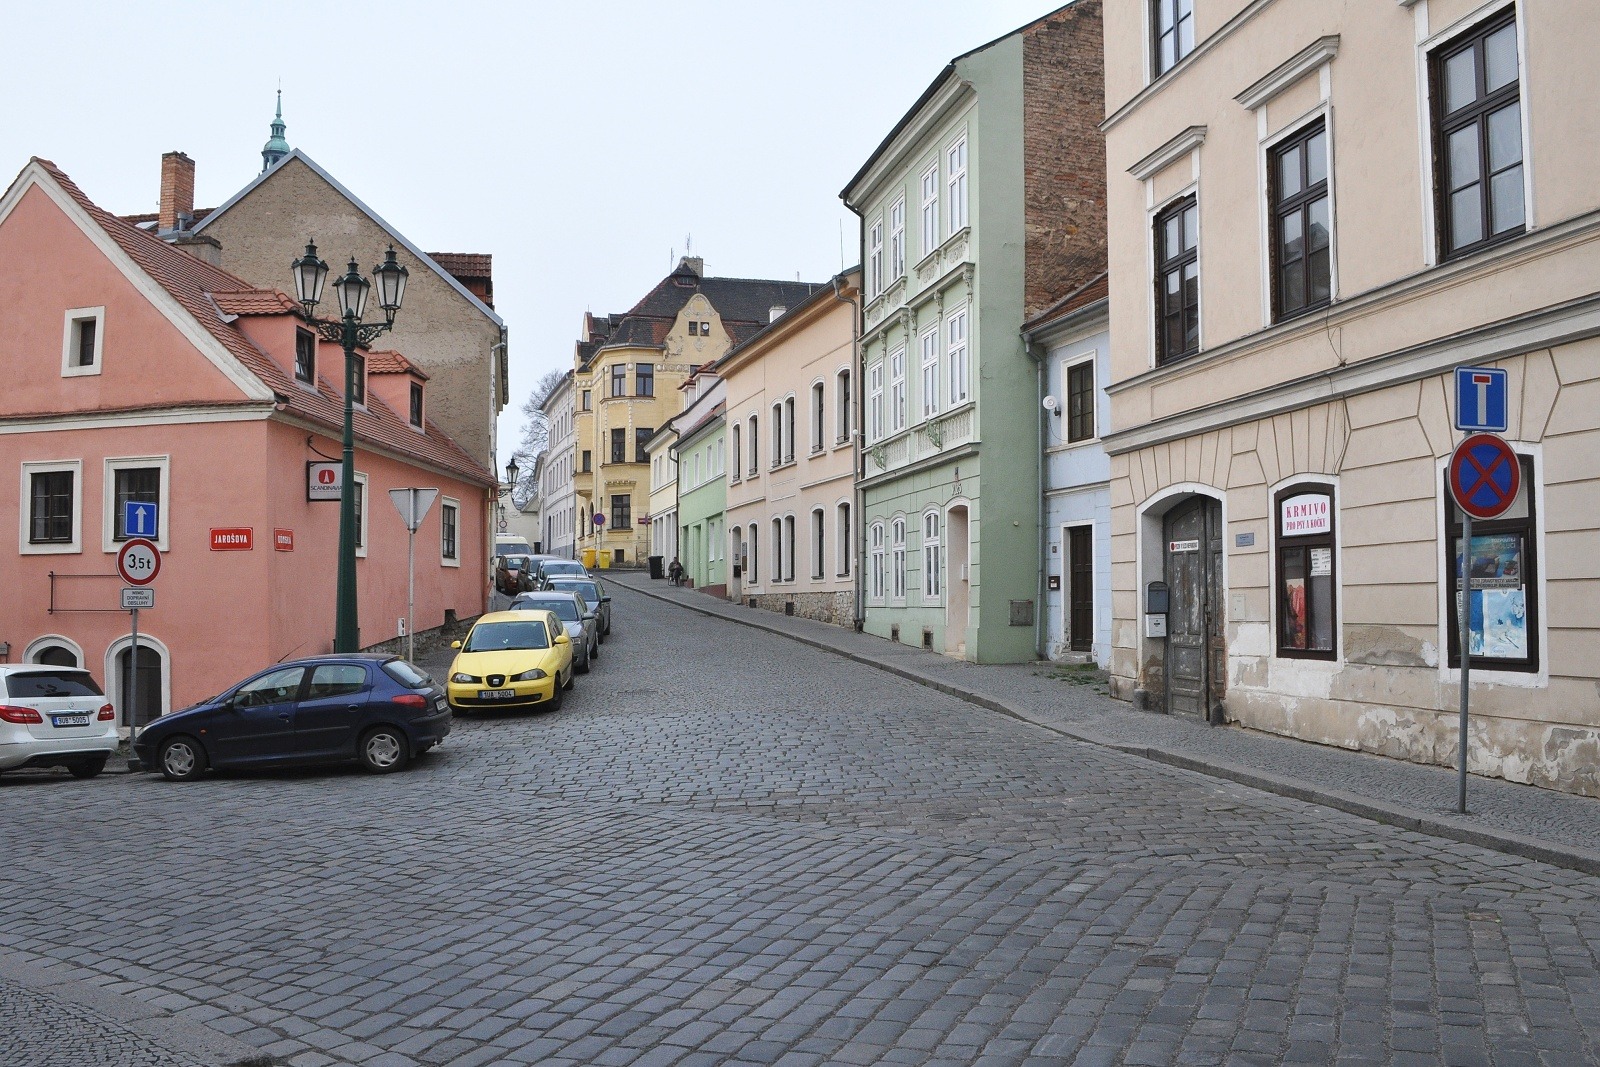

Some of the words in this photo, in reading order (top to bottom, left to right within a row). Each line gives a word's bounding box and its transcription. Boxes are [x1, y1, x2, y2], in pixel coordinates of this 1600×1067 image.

[1286, 501, 1326, 518] KRMIVO
[1286, 521, 1296, 530] PRO
[1296, 520, 1305, 530] PSY
[1306, 519, 1310, 529] A
[1310, 517, 1325, 528] KOČKY
[214, 533, 248, 544] JAROŠOVA
